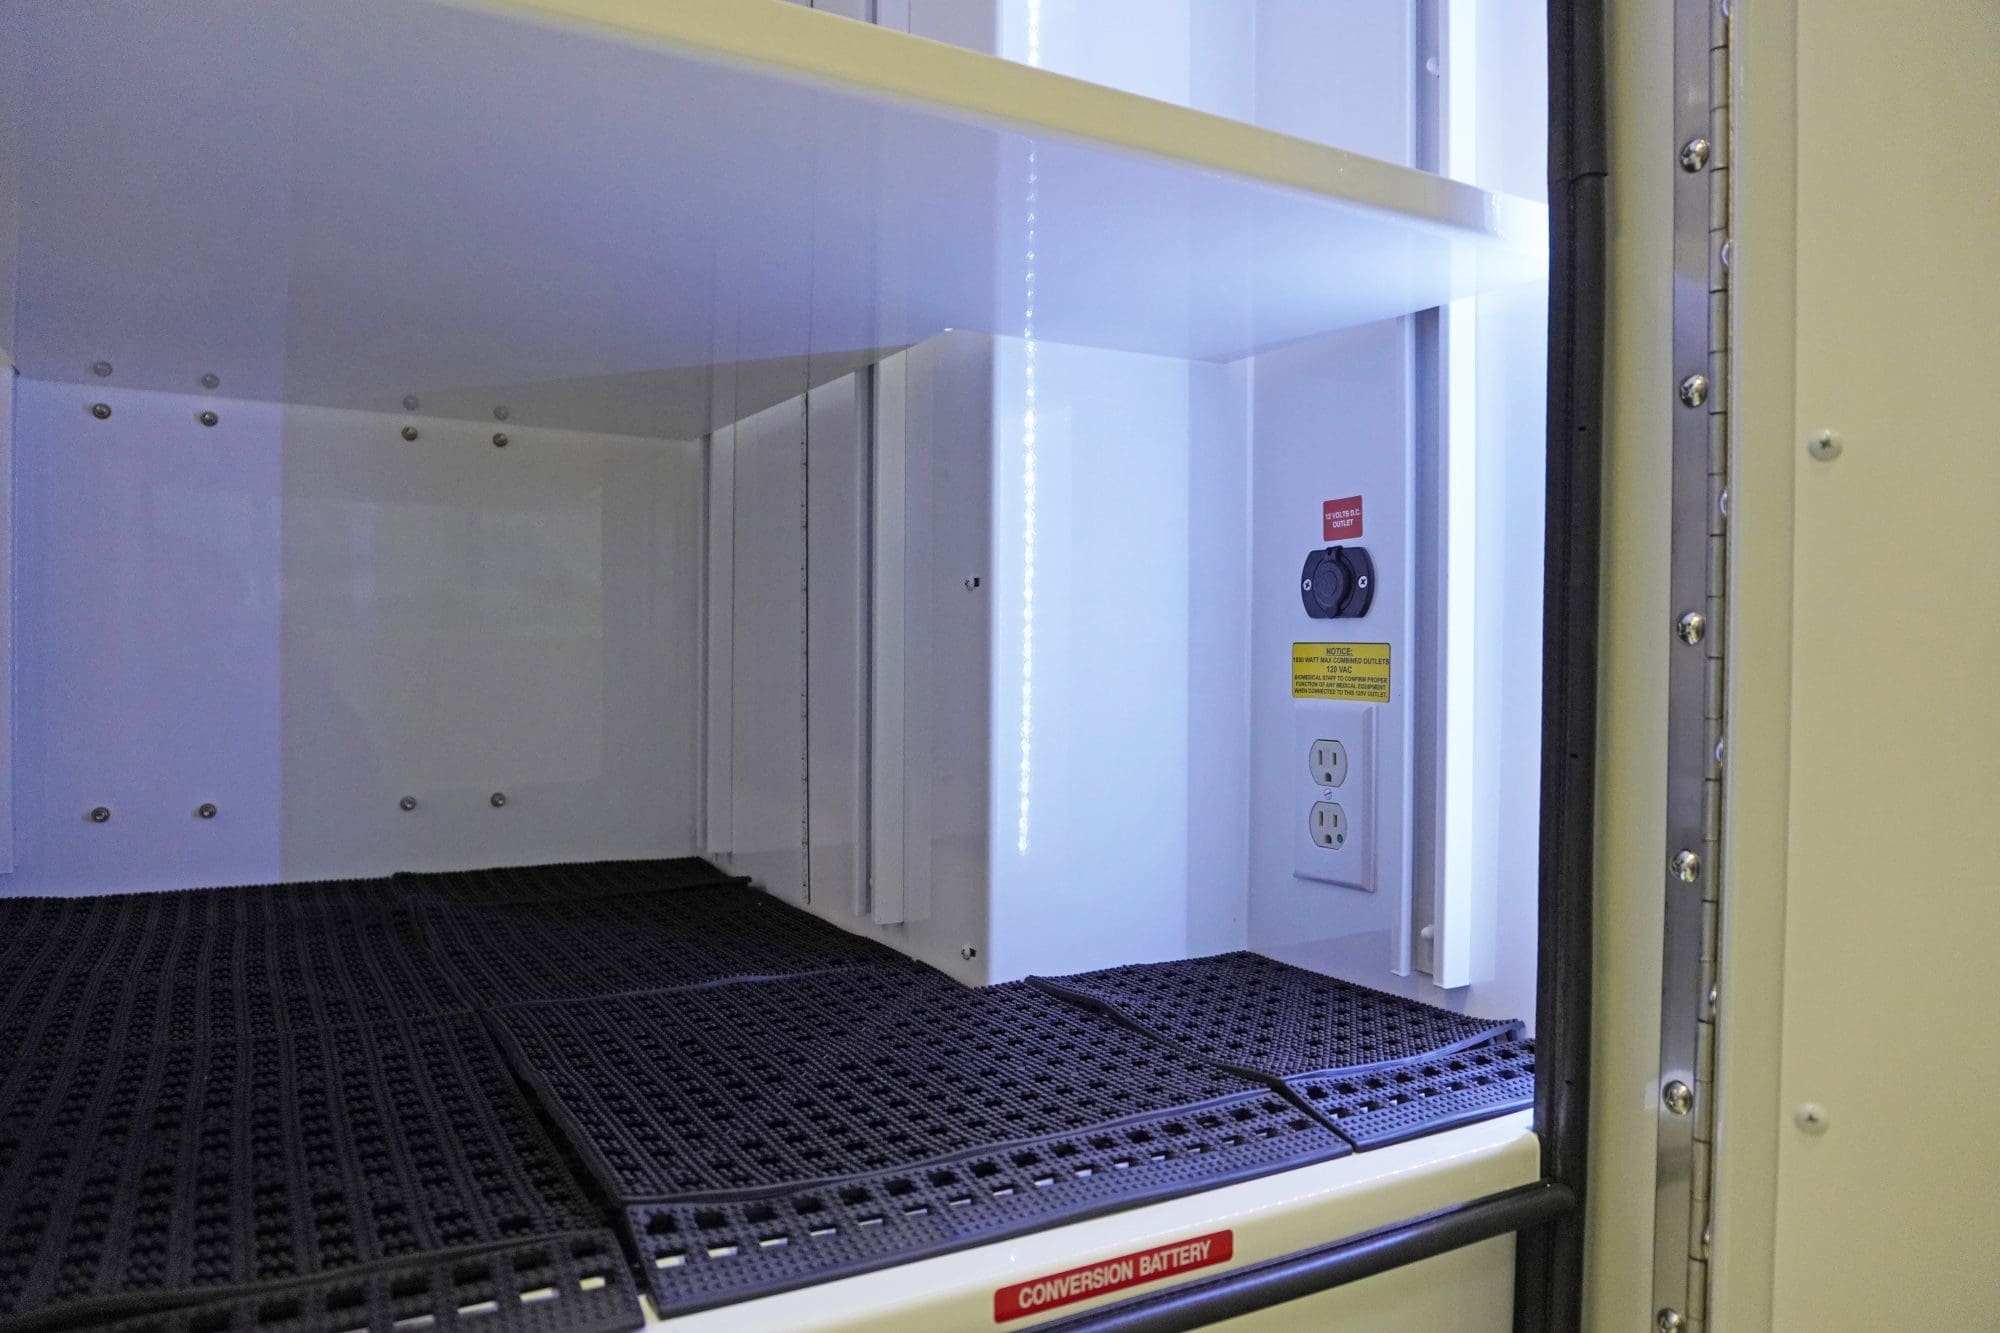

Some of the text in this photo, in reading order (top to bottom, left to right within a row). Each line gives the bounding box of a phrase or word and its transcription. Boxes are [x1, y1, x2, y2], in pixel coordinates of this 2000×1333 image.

[1325, 512, 1331, 520] 12
[1332, 510, 1349, 518] VOLTS
[1332, 519, 1353, 528] OUTLET
[1327, 648, 1353, 656] NOTICE:
[1018, 1239, 1212, 1309] CONVERSION BATTERY
